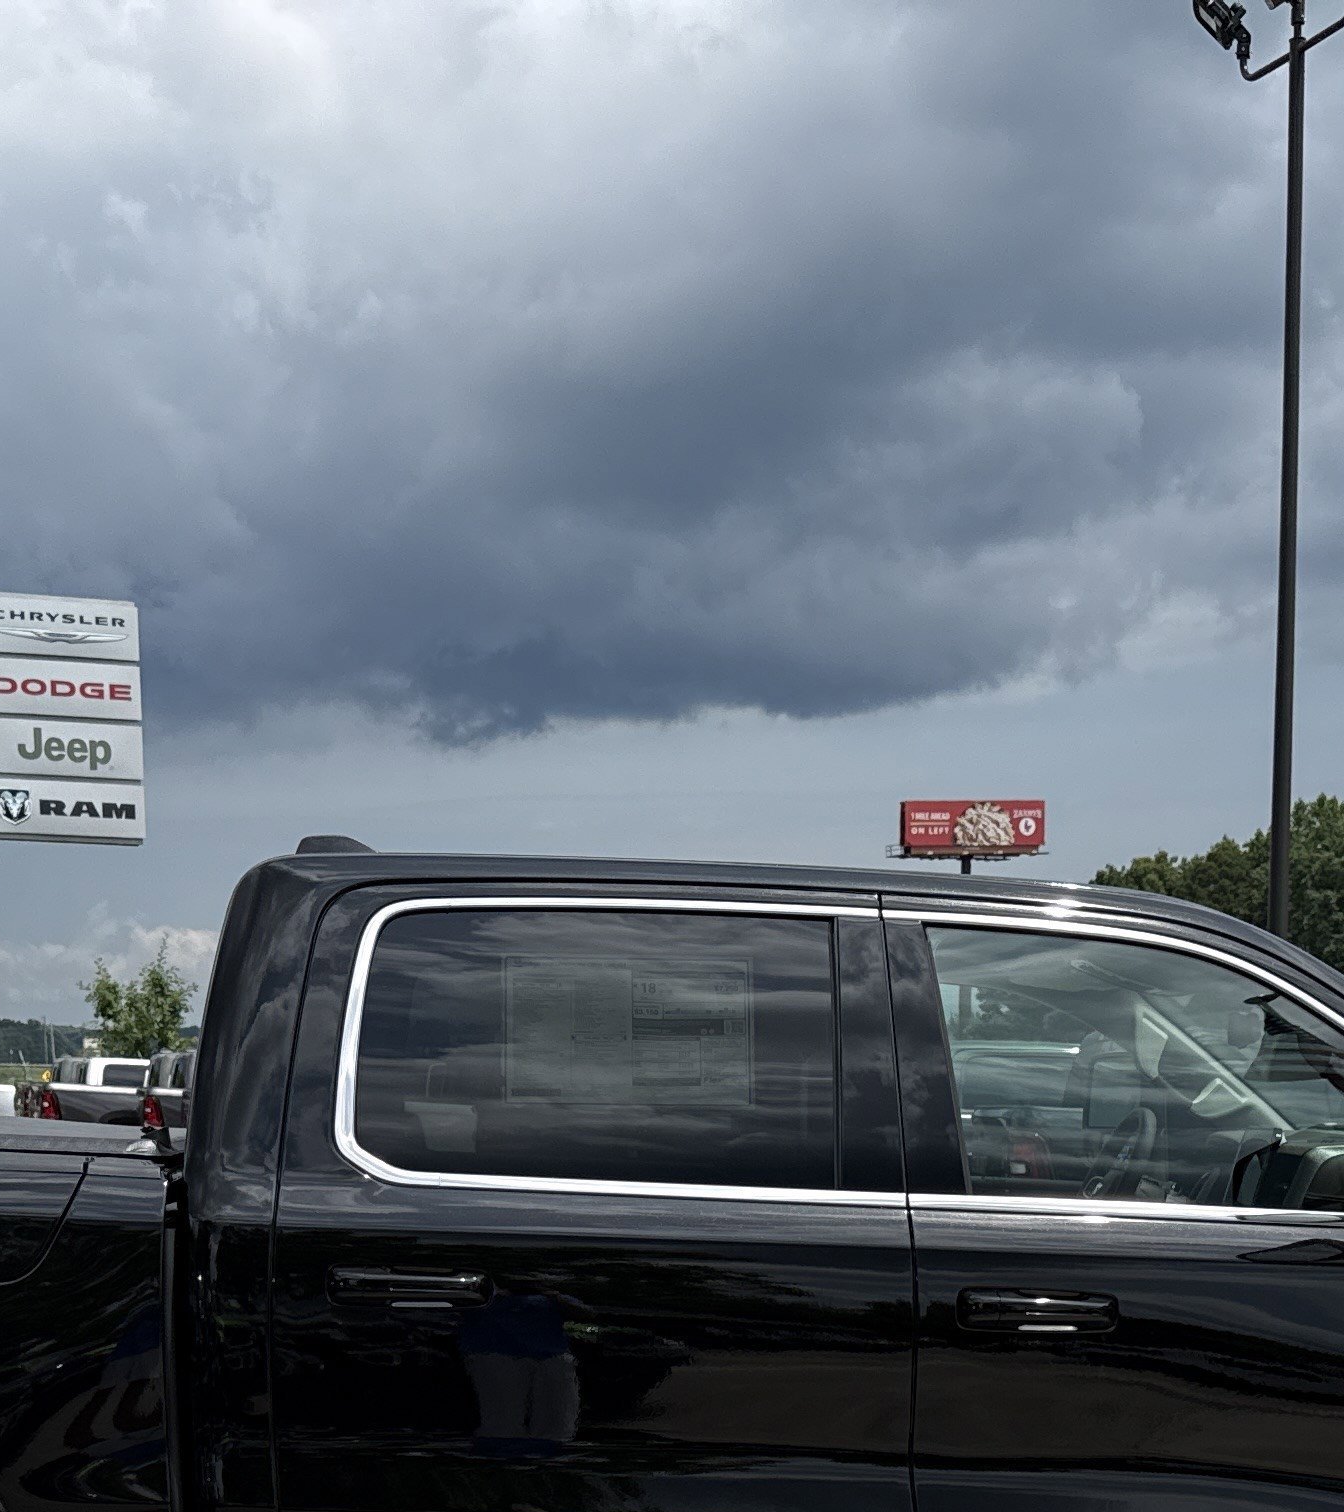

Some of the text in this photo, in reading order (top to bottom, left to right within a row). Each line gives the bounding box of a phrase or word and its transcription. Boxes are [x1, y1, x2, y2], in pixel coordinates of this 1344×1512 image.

[17, 727, 112, 770] Jeep
[38, 799, 136, 820] RAM
[910, 826, 950, 834] ON LEFT
